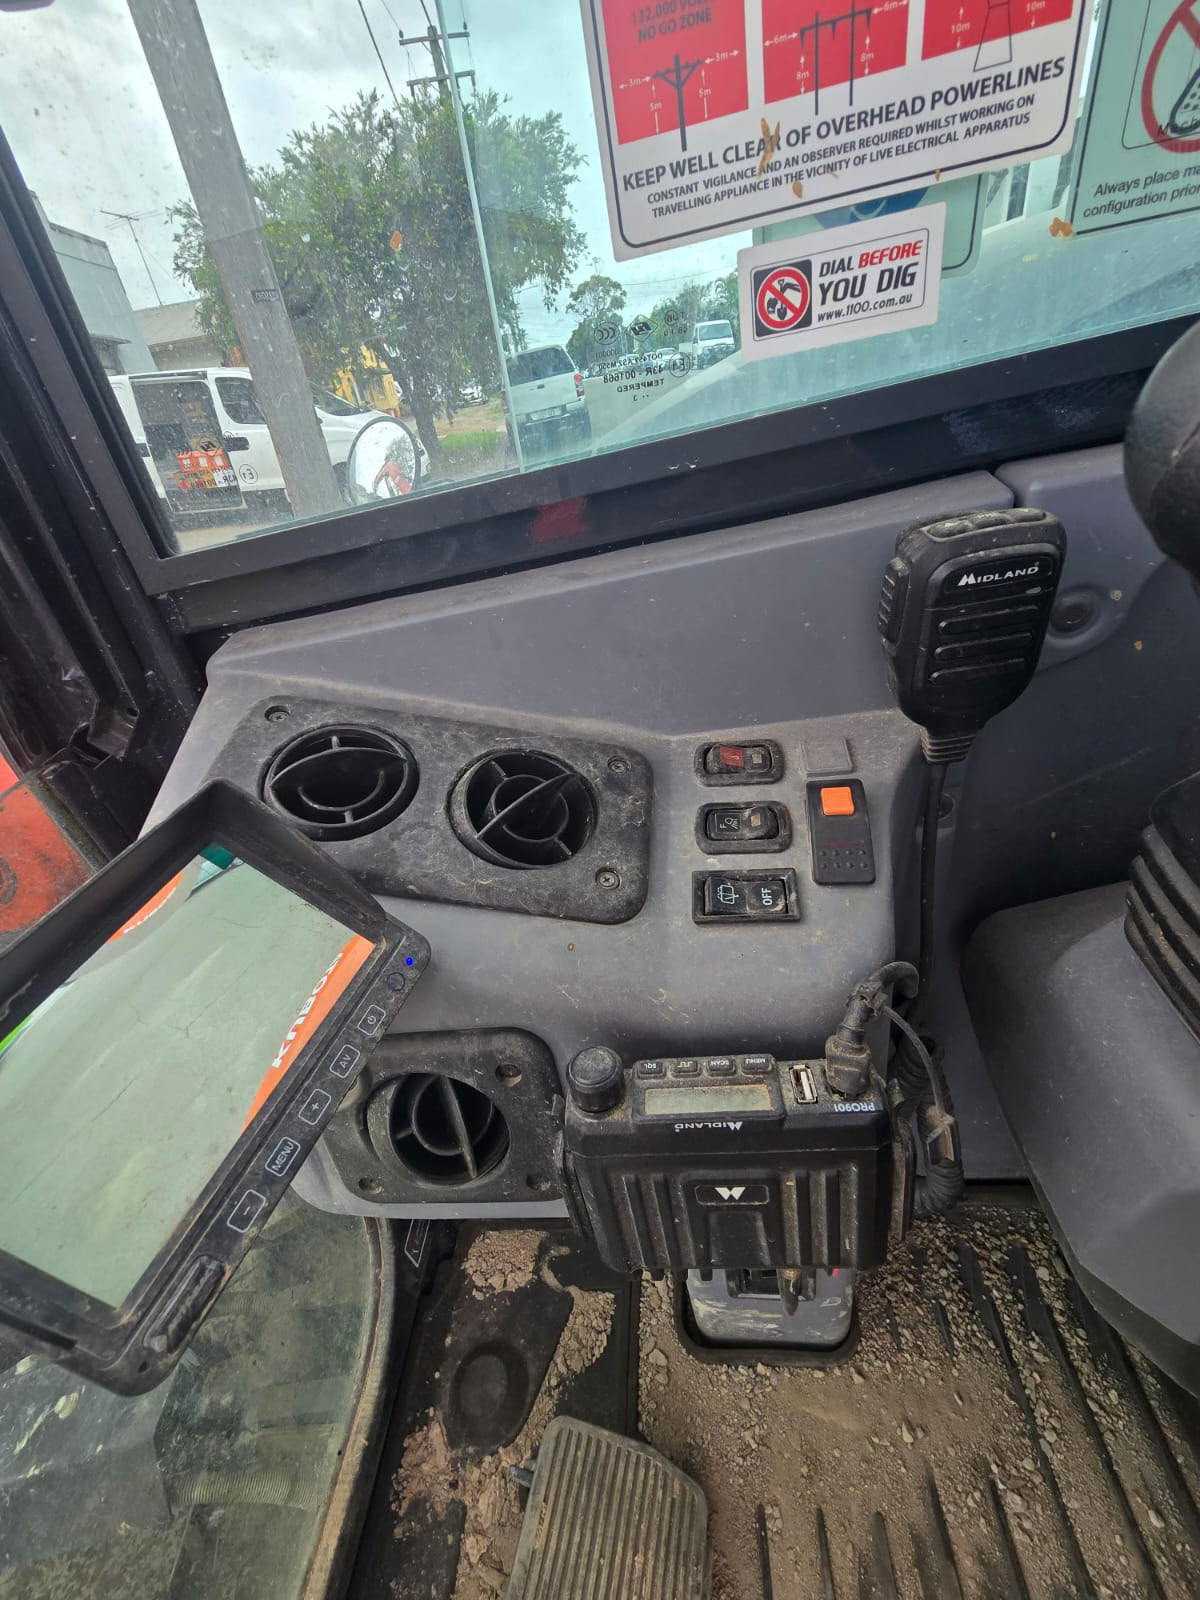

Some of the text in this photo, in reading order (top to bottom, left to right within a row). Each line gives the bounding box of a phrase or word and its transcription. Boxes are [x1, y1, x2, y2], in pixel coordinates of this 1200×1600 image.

[883, 1, 898, 12] 6m
[1026, 1, 1045, 12] 10m
[638, 8, 712, 41] NO GO ZONE
[952, 22, 970, 34] 10m
[774, 34, 787, 44] 6m
[715, 51, 728, 61] 3m
[860, 52, 874, 62] 8m
[628, 78, 641, 88] 3m
[699, 88, 711, 97] 5m
[650, 102, 662, 111] 5m
[622, 164, 666, 191] KEEP
[669, 151, 719, 179] WELL
[786, 126, 811, 148] OF
[816, 96, 925, 140] OVERHEAD
[930, 56, 1065, 111] POWERLINES
[647, 94, 1035, 204] CONSTANT VIGILANCE AND AN OBSERVER REQUIRED WHILST WORKING ON
[652, 113, 1031, 218] TRAVELLING APPLIANCE IN THE VICINITY OF LIVE ELECTRICAL APPARATUS
[1093, 178, 1141, 198] Always
[1143, 169, 1180, 189] place
[1083, 191, 1168, 218] configuration
[819, 240, 923, 278] DIAL BEFORE
[819, 261, 919, 306] YOU DIG
[817, 293, 912, 322] www.1100.com.au
[957, 566, 1039, 586] MIDLAND
[762, 888, 773, 906] OFF
[339, 1053, 351, 1069] AV
[833, 1102, 876, 1112] PRO901
[674, 1121, 744, 1131] MIDLAND
[272, 1141, 295, 1172] MENU
